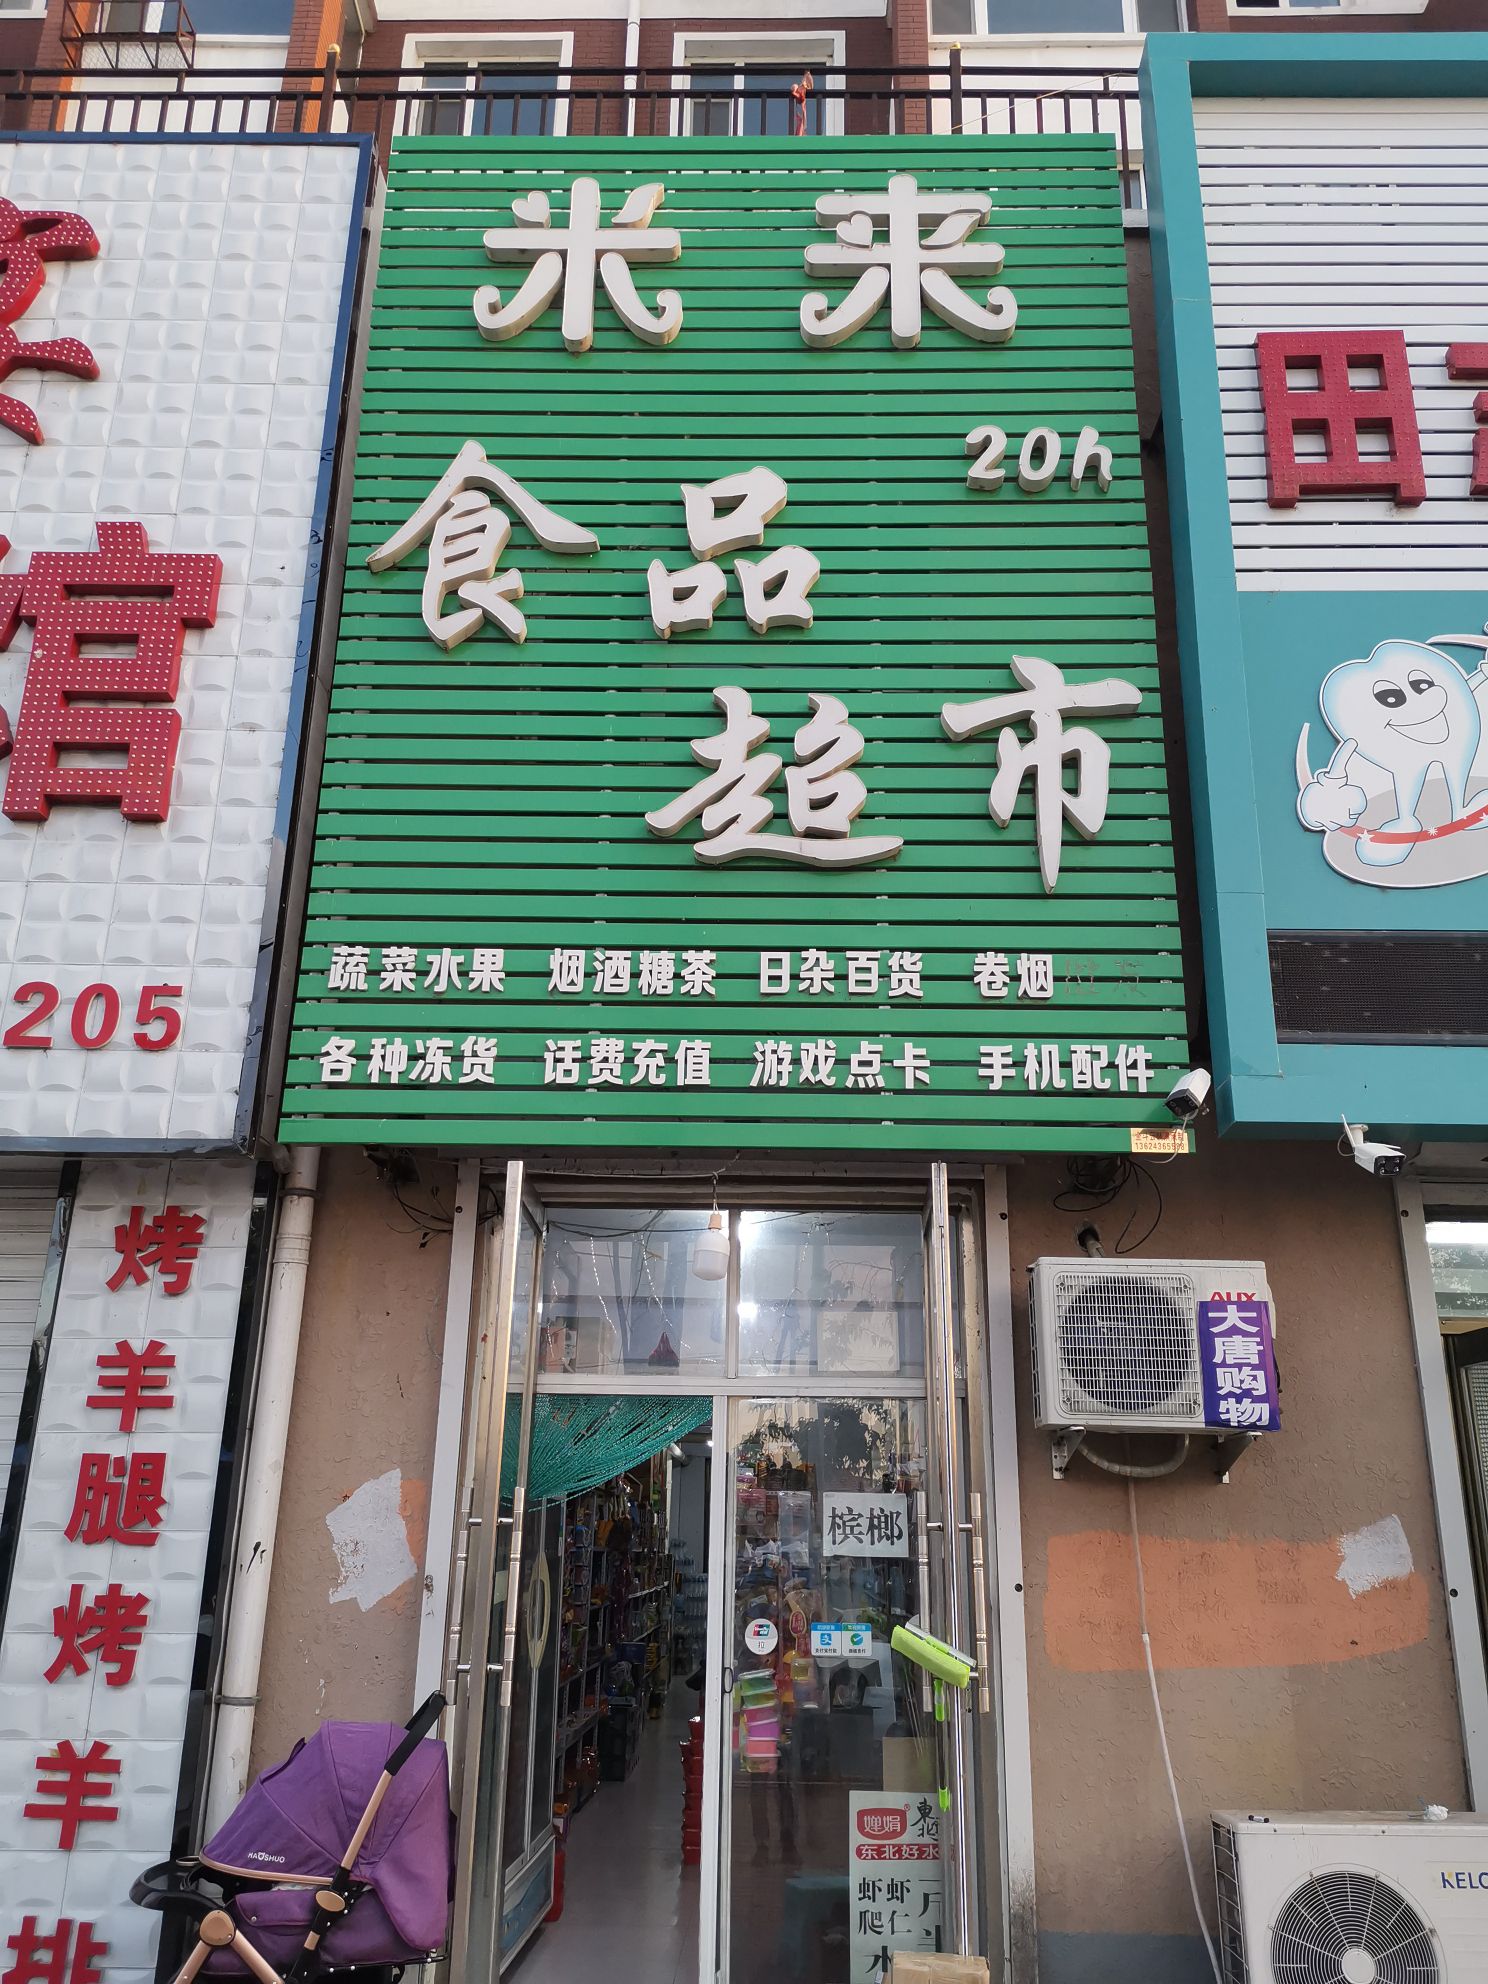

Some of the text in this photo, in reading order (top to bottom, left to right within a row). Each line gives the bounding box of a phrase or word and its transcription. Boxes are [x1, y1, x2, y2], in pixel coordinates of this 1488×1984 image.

[1253, 330, 1488, 509] 田
[965, 426, 1113, 493] 20h
[366, 440, 823, 648] 食品
[645, 656, 1144, 895] 超市
[327, 946, 506, 993] 蔬菜水果
[548, 948, 718, 997] 烟酒糖茶
[758, 949, 925, 999] 日杂百货
[973, 952, 1055, 1000] 卷烟
[3, 981, 184, 1051] 205
[319, 1035, 1156, 1093] 各种冻货 话费充值 游戏点卡 手机配件
[1208, 1305, 1270, 1428] 大唐购物
[827, 1506, 904, 1547] 槟榔
